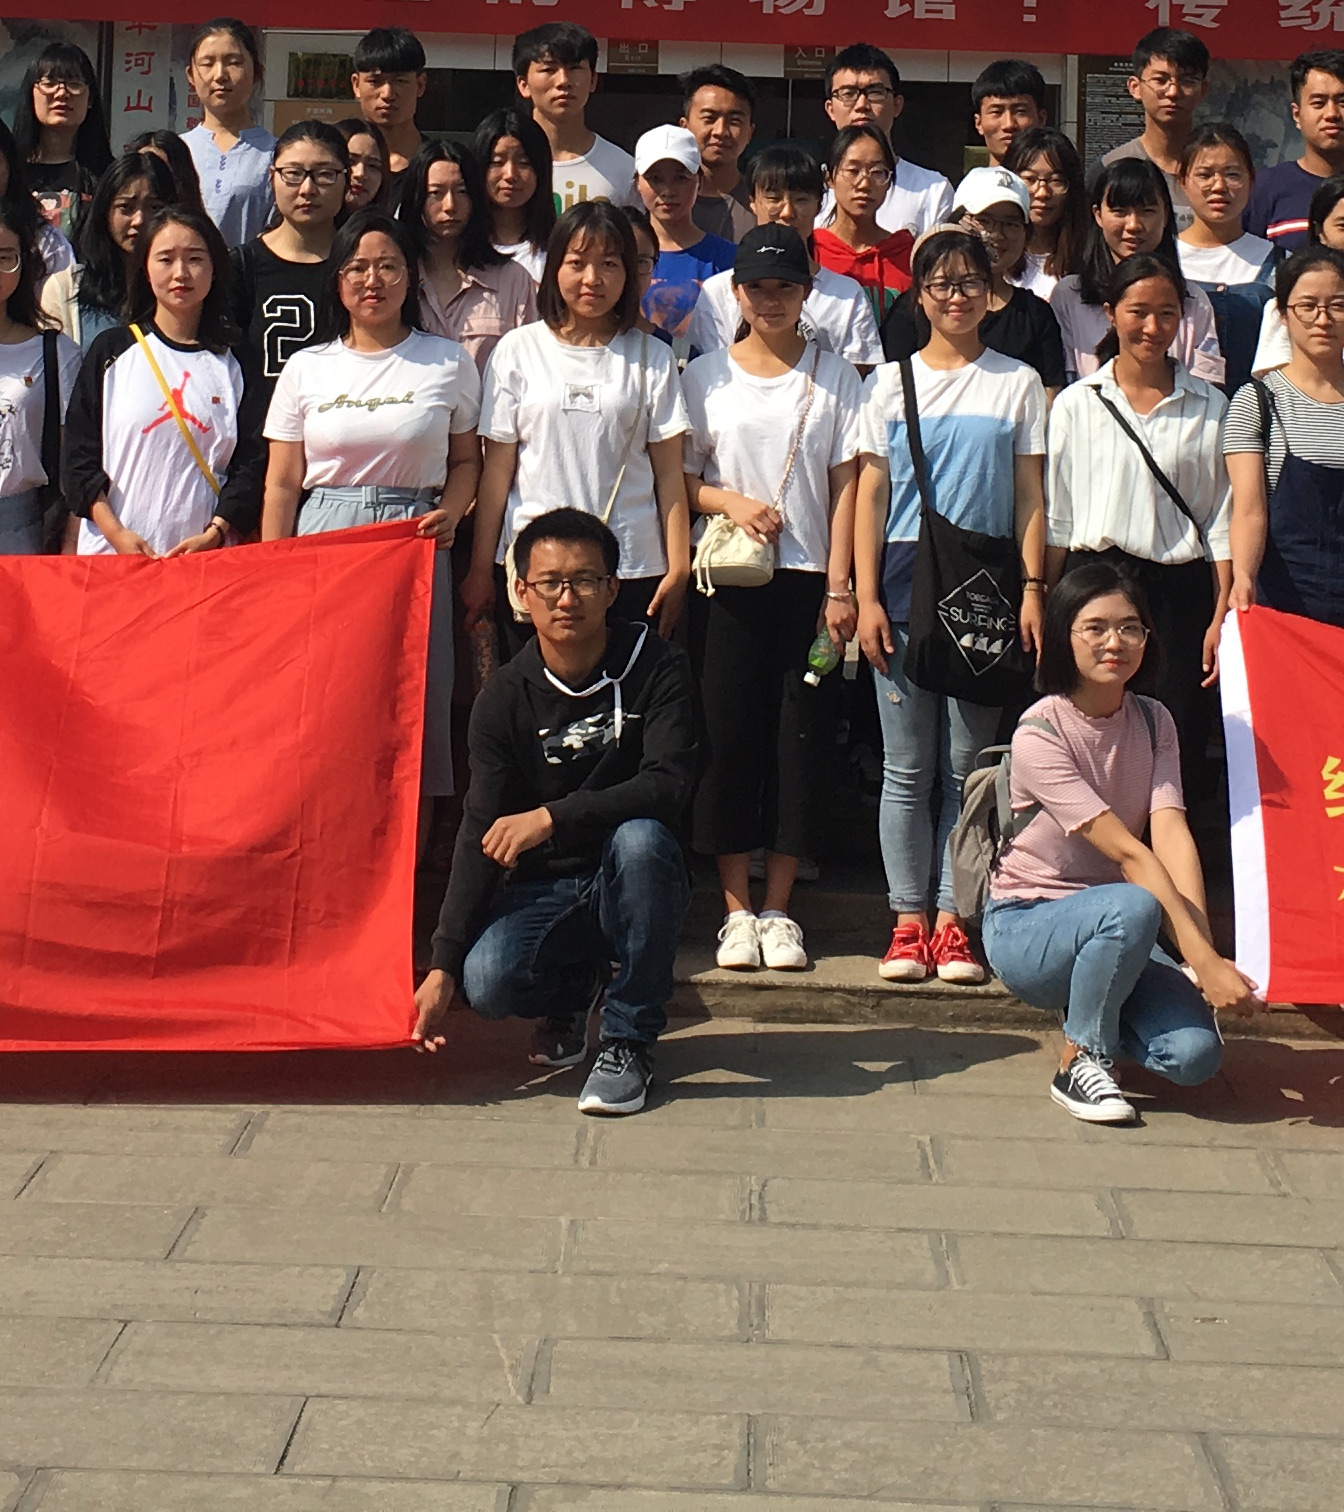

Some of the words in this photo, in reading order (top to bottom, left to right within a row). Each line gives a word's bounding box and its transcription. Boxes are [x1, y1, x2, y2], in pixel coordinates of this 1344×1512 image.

[619, 42, 649, 54] 出口
[794, 46, 825, 58] 入口
[263, 294, 315, 377] 2
